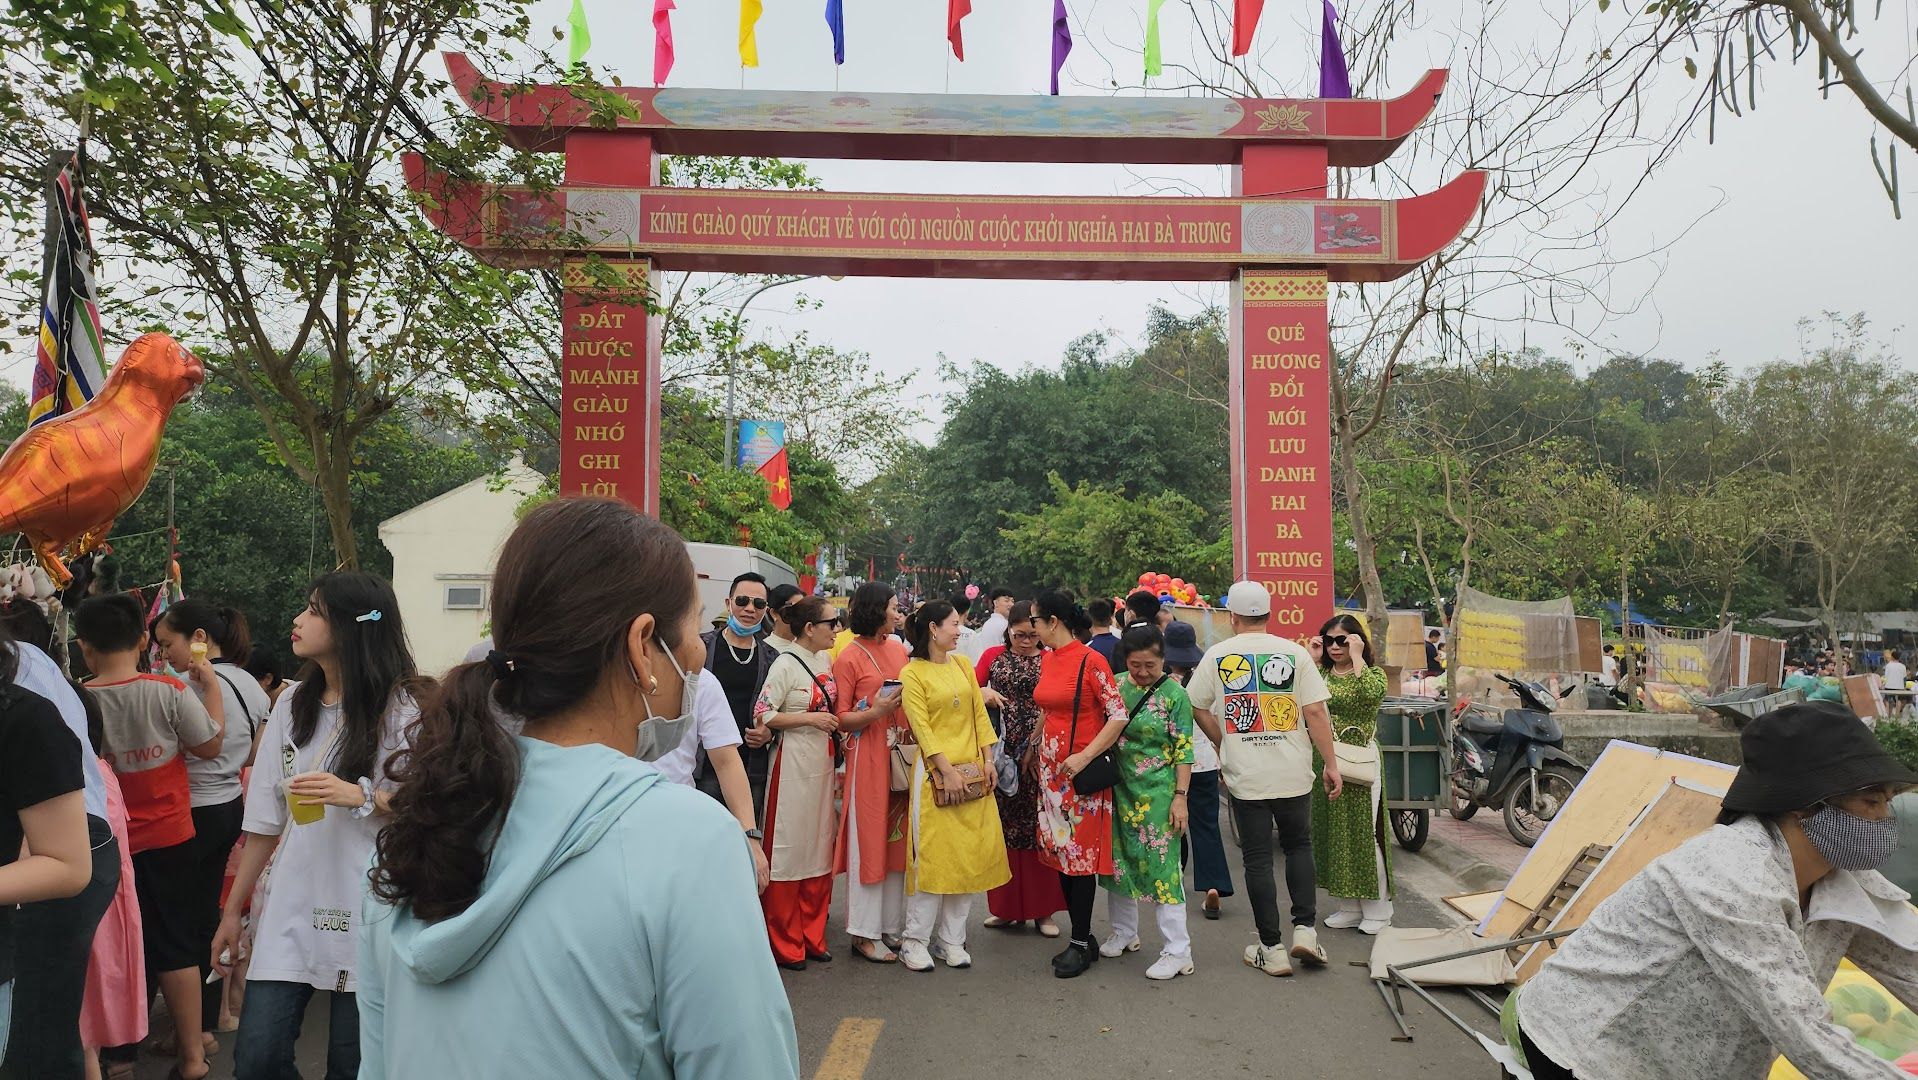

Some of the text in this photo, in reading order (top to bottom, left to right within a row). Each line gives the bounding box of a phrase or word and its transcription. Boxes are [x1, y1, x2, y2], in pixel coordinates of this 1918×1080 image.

[650, 204, 1231, 248] KÍNH CHÀO QUÝ KHÁCH VỀ VỚI CỘI NGUỒN CUỘC KHỞI NGHĨA HAI BÀ TRƯNG
[579, 305, 625, 329] ĐẤT
[1267, 322, 1305, 345] QUÊ
[569, 337, 633, 357] NƯỚC
[1251, 353, 1321, 370] HƯƠNG
[569, 369, 639, 388] MẠNH
[1269, 374, 1305, 398] ĐỔI
[573, 393, 629, 413] GIÀU
[1267, 405, 1307, 426] MỚI
[575, 422, 625, 442] NHỚ
[1269, 438, 1306, 454] LƯU
[579, 454, 620, 470] GHI
[1260, 467, 1316, 482] DANH
[581, 478, 618, 498] LỜI
[1271, 495, 1306, 511] HAI
[1276, 518, 1302, 539] BÀ
[1256, 551, 1323, 568] TRƯNG
[1263, 579, 1319, 600] DỰNG
[1278, 604, 1304, 625] CỜ
[123, 745, 163, 767] TWO
[320, 918, 350, 932] HUG
